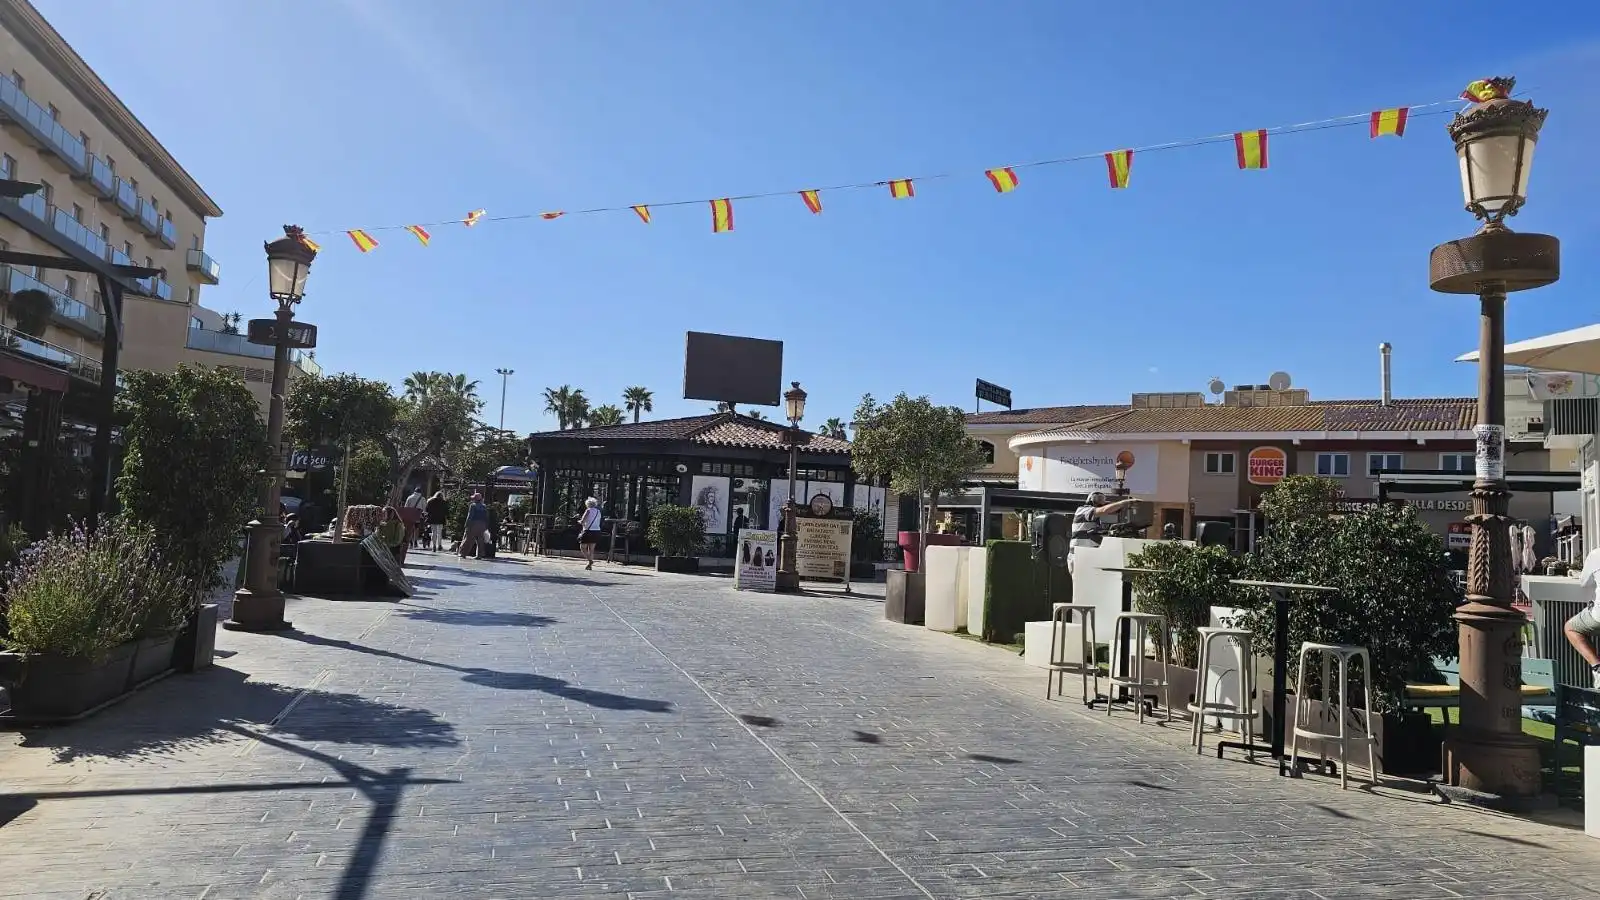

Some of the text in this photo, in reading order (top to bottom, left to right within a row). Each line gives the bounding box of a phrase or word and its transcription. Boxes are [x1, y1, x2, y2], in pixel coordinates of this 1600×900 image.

[1250, 458, 1284, 467] BURGER
[1250, 466, 1284, 477] KING
[1335, 502, 1362, 512] SINCE
[1437, 500, 1472, 511] DESDE
